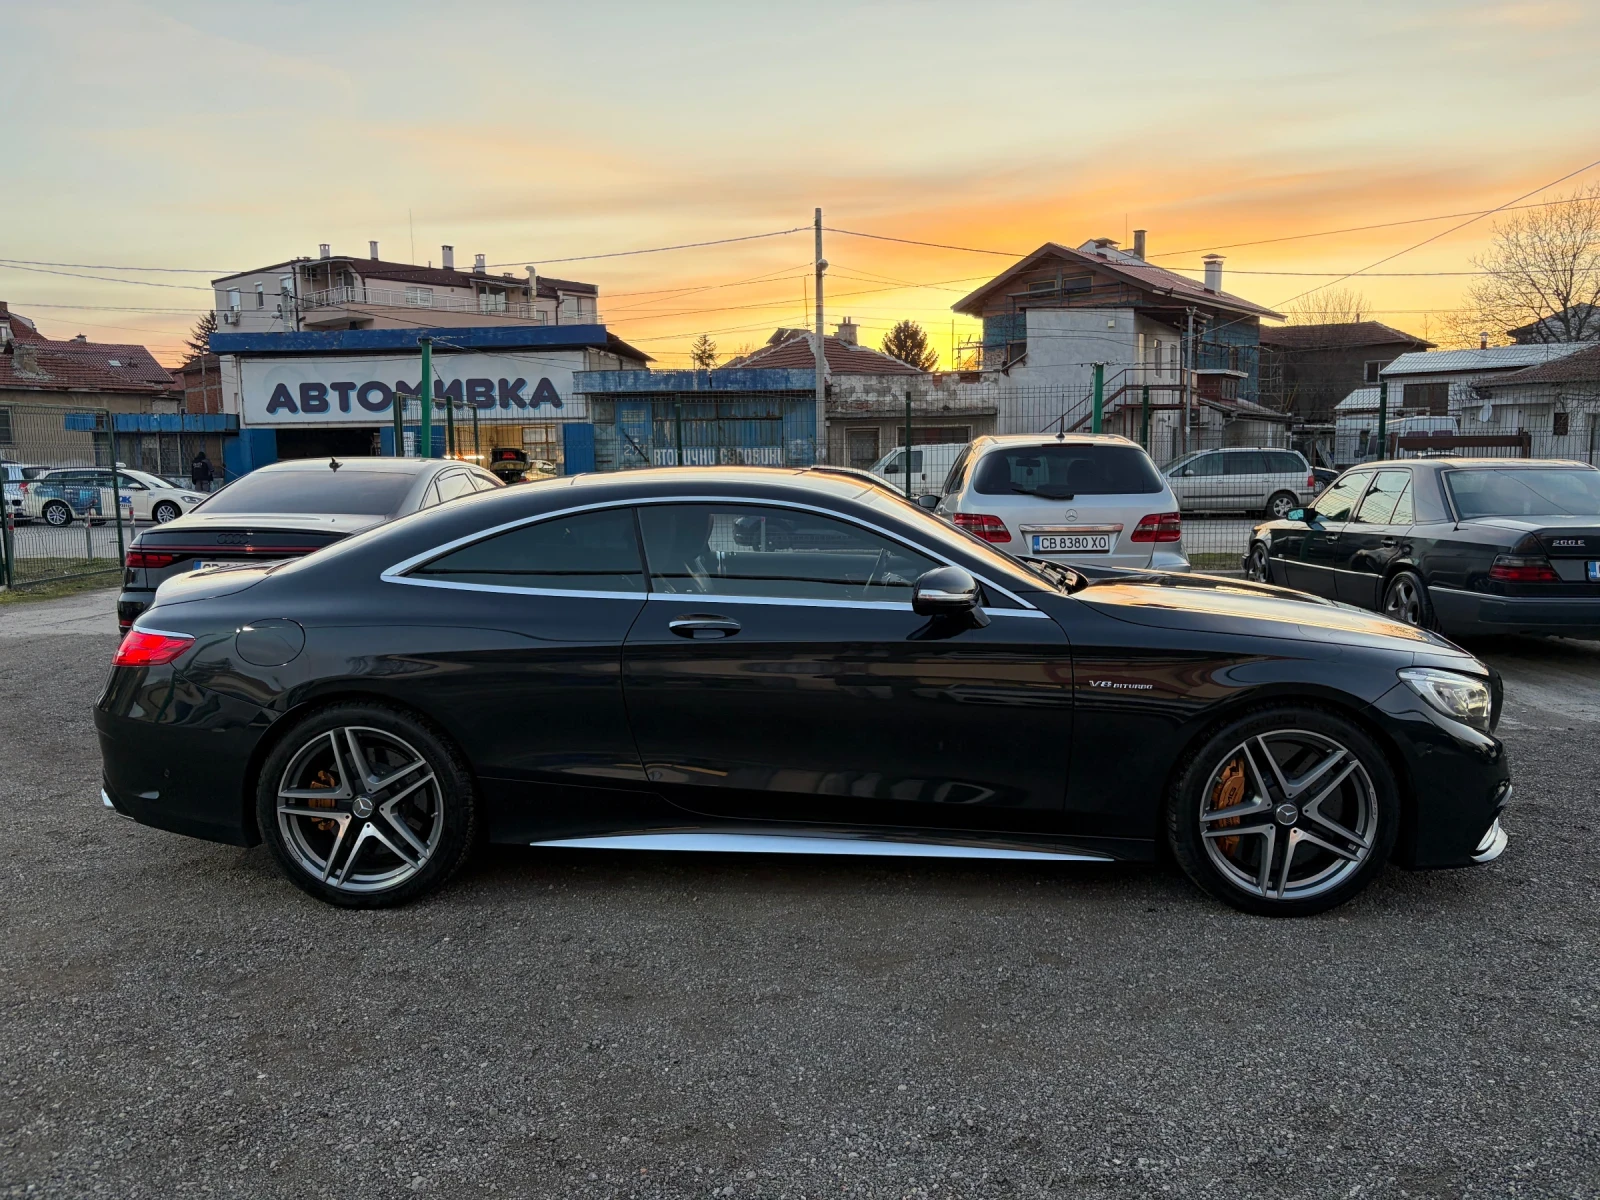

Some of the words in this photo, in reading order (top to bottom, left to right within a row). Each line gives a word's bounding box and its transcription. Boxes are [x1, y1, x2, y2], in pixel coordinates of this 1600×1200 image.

[266, 377, 563, 414] АВТОМИВКА
[1041, 537, 1057, 549] CB
[1059, 537, 1089, 549] 8380
